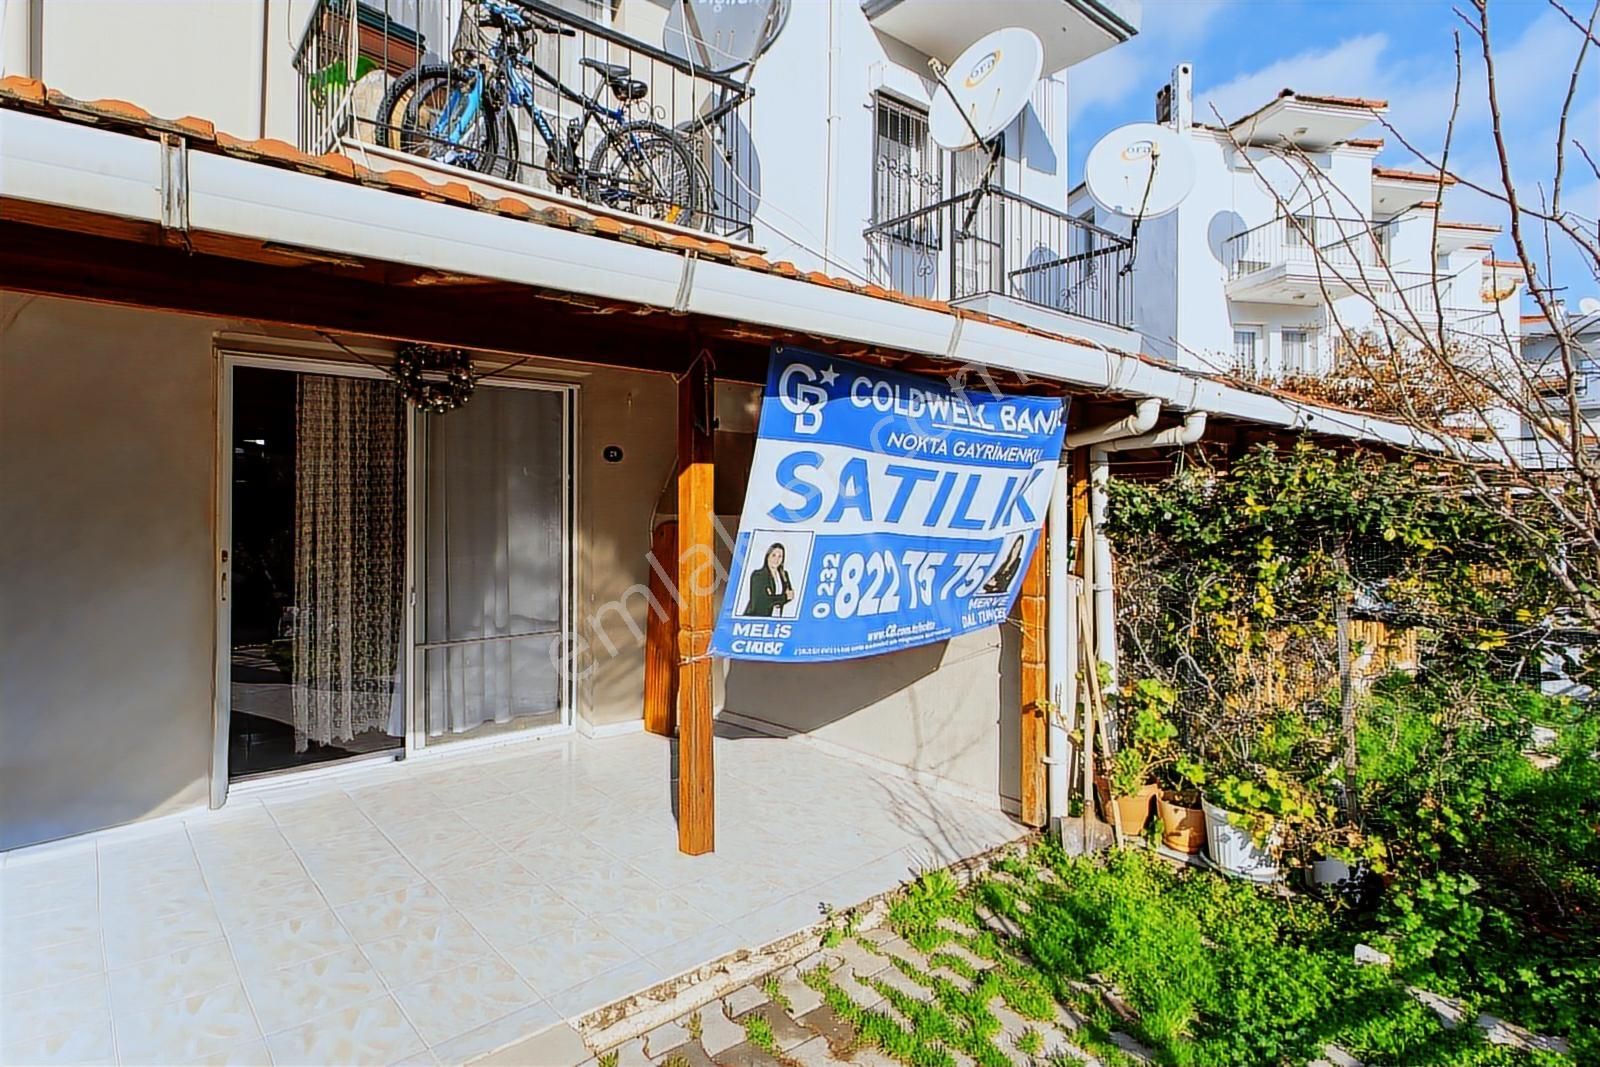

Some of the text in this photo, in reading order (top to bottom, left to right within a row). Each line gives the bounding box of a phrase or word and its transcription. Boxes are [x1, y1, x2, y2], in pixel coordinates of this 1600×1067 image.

[850, 375, 994, 431] COLDWELL
[887, 431, 947, 456] NOKTA
[766, 450, 1043, 530] SATILIK
[817, 552, 841, 597] 232
[835, 550, 900, 619] 822
[902, 549, 948, 610] 75
[940, 552, 996, 601] 75
